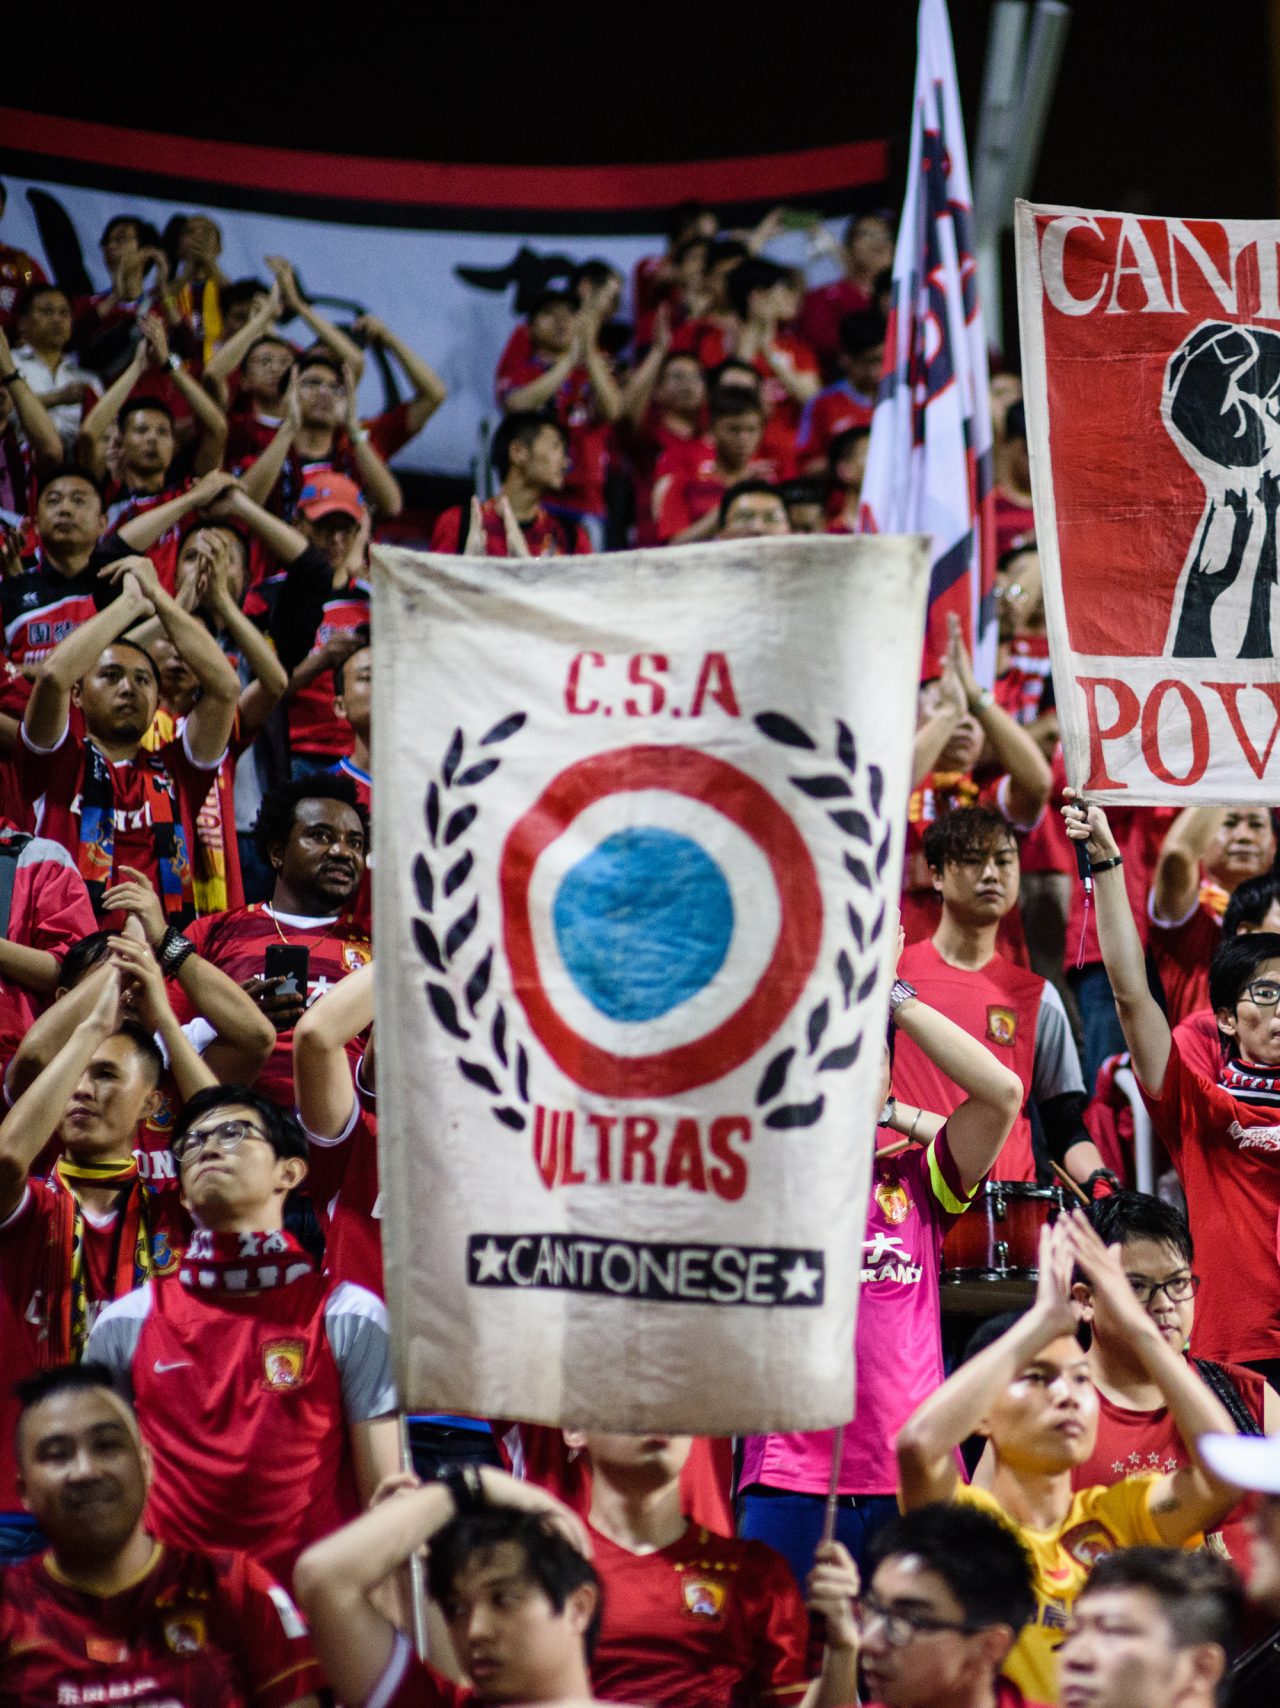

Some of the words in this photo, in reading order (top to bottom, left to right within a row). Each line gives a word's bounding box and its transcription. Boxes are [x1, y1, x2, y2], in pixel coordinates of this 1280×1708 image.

[565, 651, 740, 717] C.S.A
[532, 1104, 752, 1203] ULTRAS
[507, 1237, 776, 1304] CANTONESE
